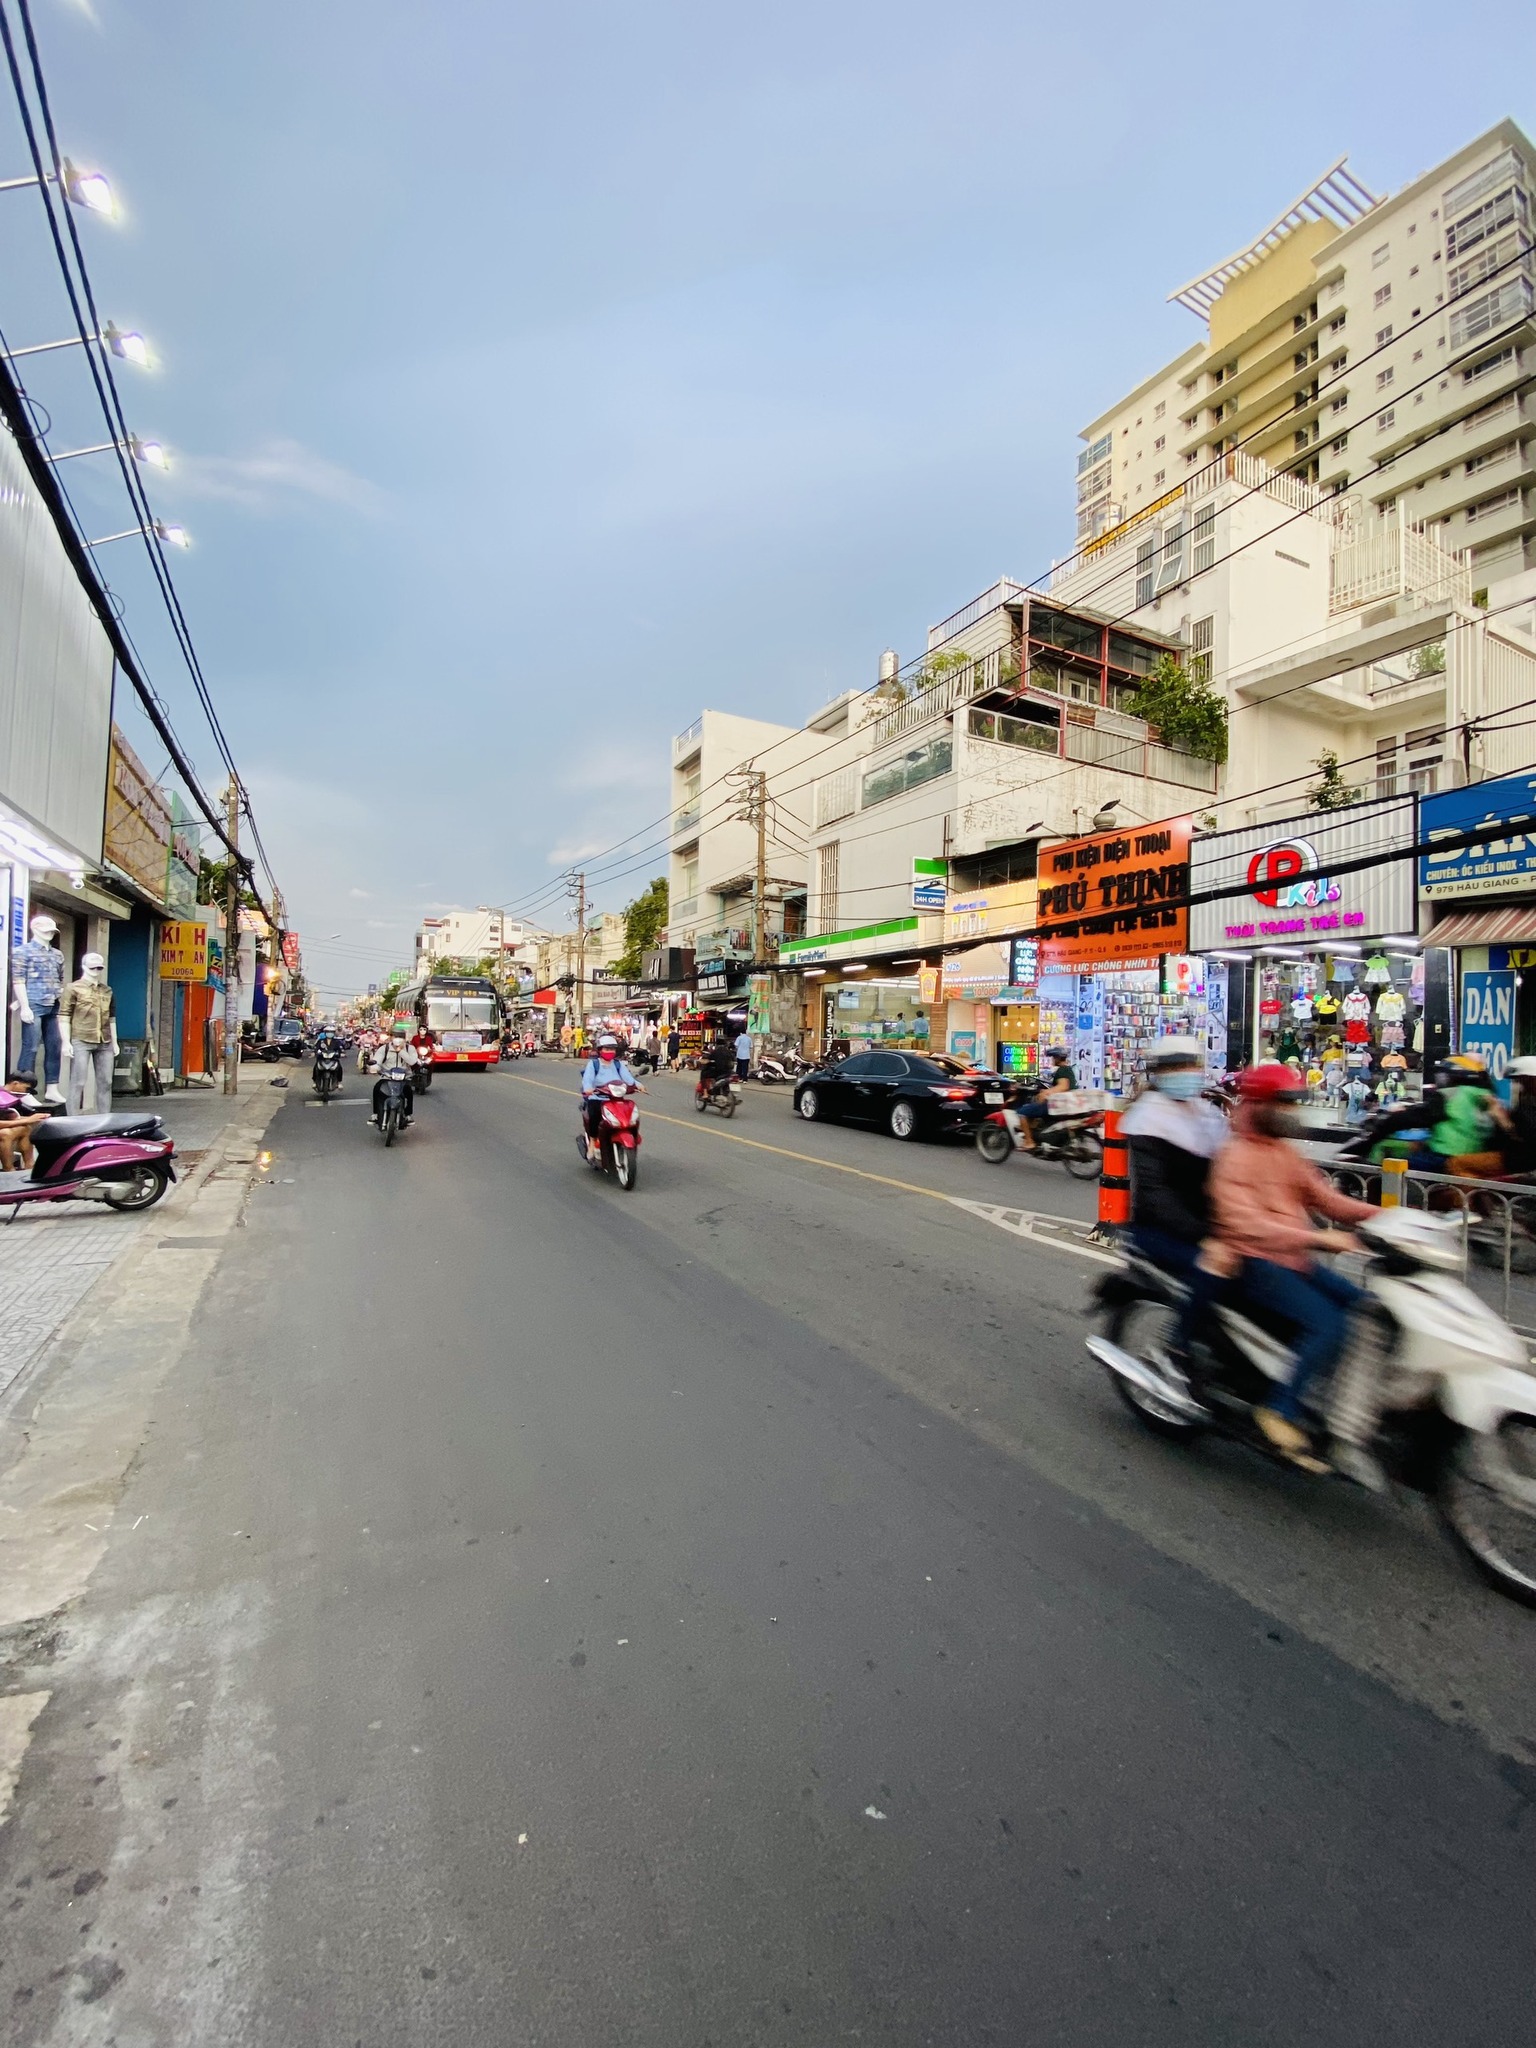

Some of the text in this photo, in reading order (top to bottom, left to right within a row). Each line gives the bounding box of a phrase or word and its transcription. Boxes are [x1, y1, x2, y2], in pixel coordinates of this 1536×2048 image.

[1497, 860, 1517, 871] INOX
[1038, 862, 1189, 916] PHÚ THỊNH
[1483, 877, 1519, 888] GIANG
[915, 895, 927, 903] 24H
[1259, 918, 1305, 935] TRANG
[1343, 912, 1365, 927] EM
[161, 950, 176, 963] KIM
[797, 949, 827, 962] FamilyMart
[1465, 975, 1511, 1025] DÁN
